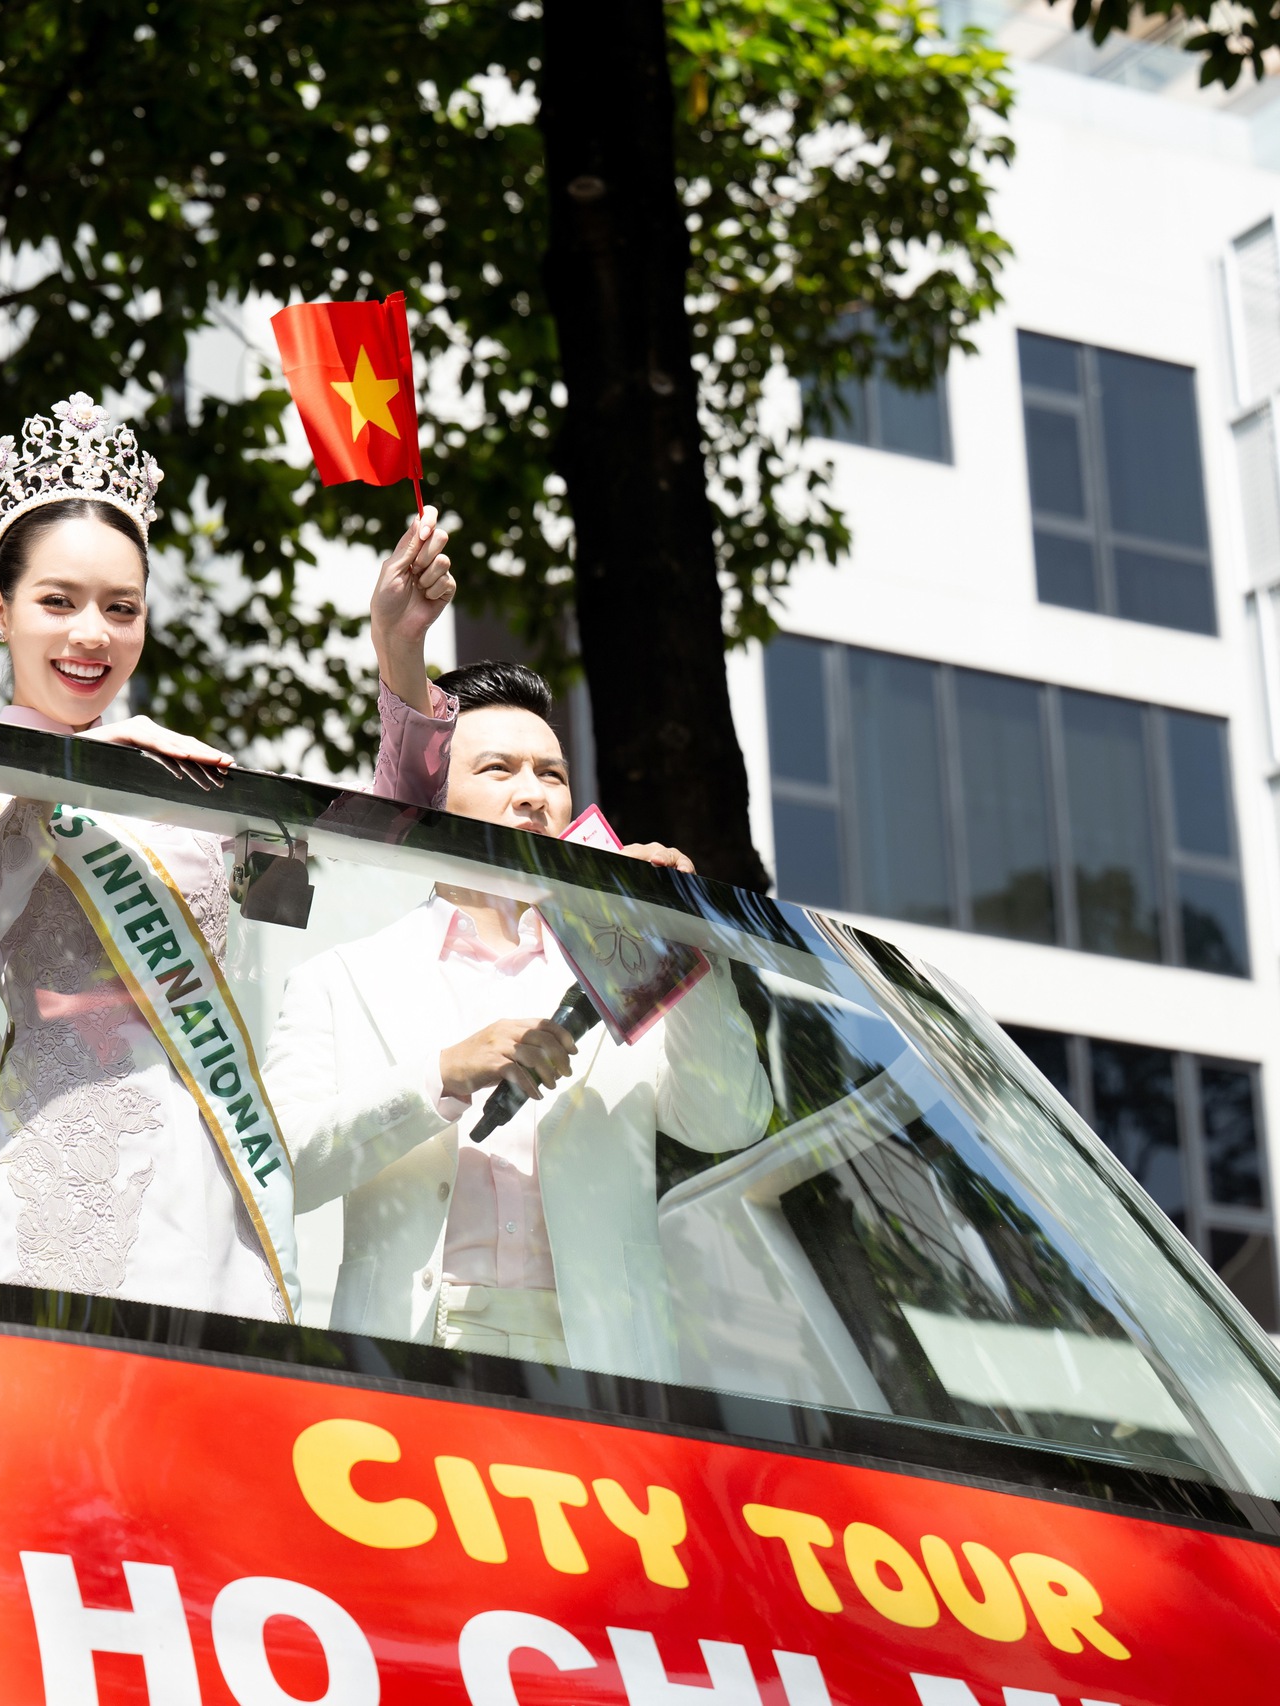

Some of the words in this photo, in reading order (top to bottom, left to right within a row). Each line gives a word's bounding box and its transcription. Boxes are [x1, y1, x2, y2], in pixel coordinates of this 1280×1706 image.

[82, 840, 283, 1188] INTERNATIONAL
[19, 1550, 381, 1706] HO
[292, 1418, 690, 1589] CITY
[742, 1503, 1132, 1660] TOUR
